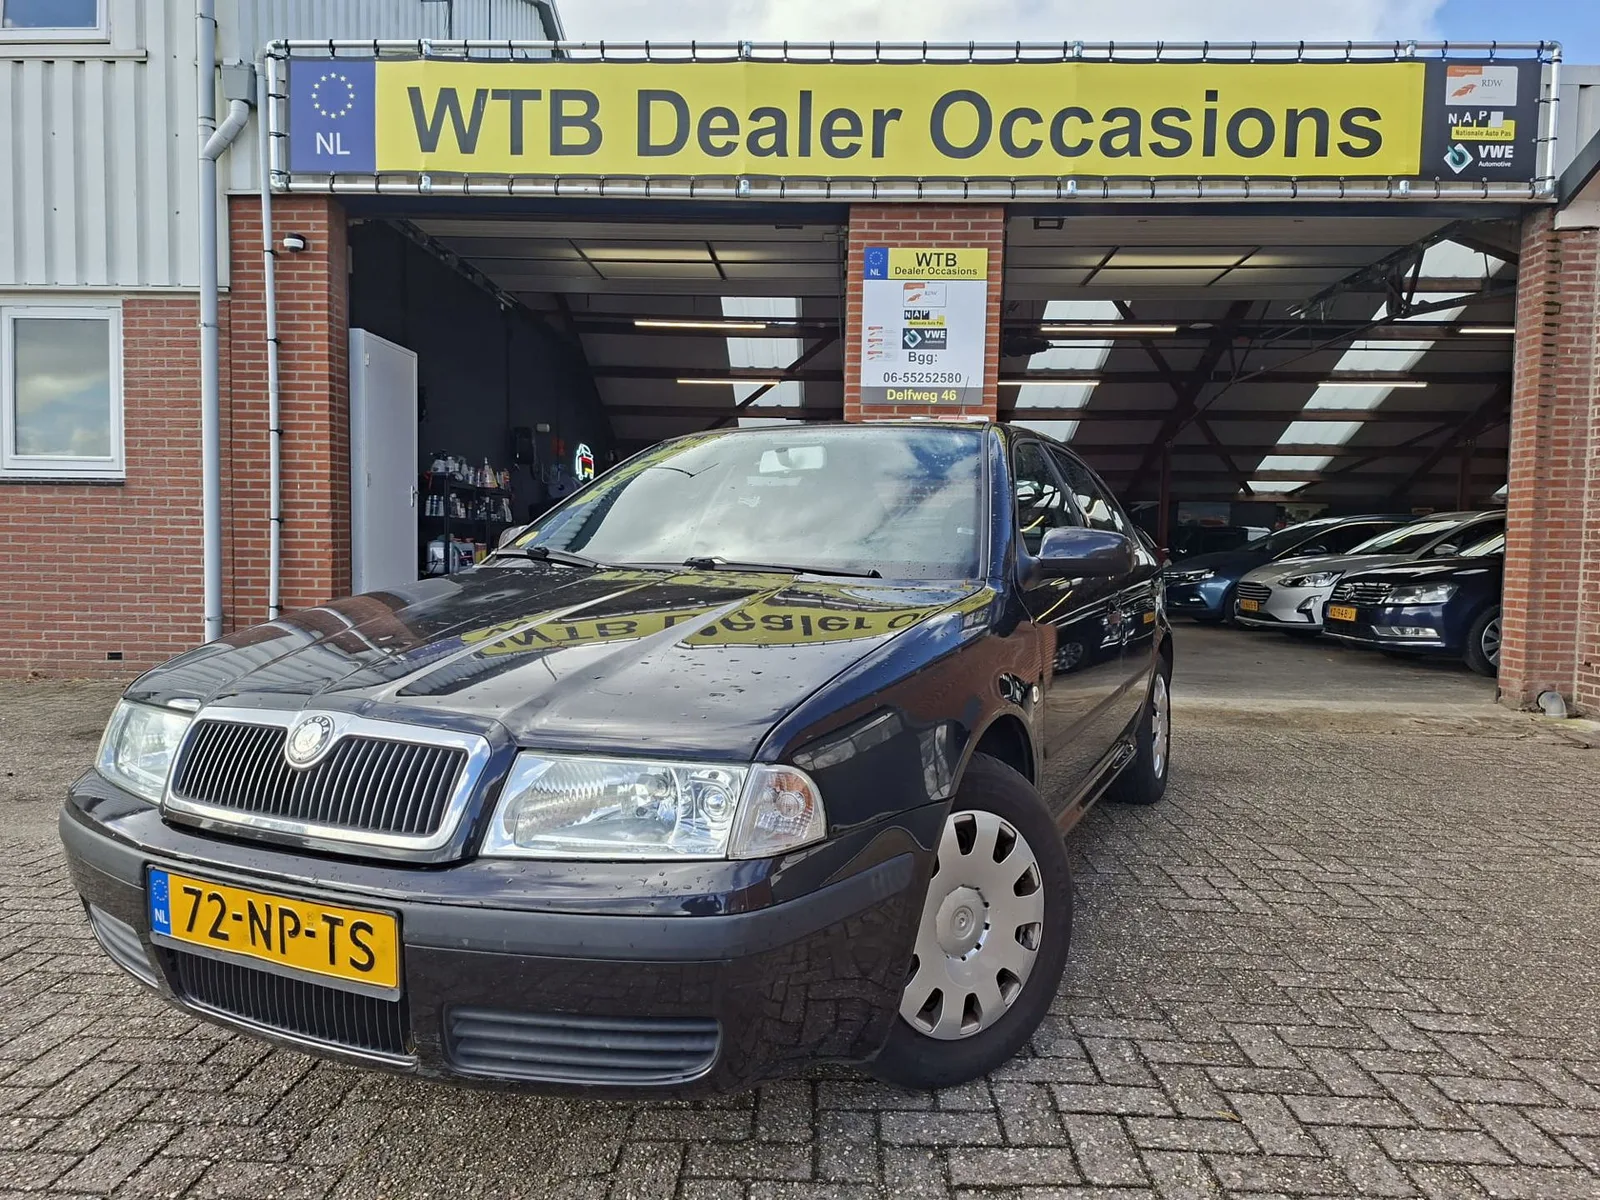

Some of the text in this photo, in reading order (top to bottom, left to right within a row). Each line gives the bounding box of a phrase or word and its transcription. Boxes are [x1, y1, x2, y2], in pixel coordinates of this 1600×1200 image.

[1481, 79, 1503, 88] RDW
[407, 86, 1383, 159] WTB Dealer Occasions
[1500, 129, 1512, 137] Pas
[315, 132, 351, 155] NL
[1478, 145, 1514, 159] VWE
[916, 252, 957, 267] WTB
[894, 266, 978, 276] Dealer Occasions
[924, 330, 946, 339] VWE
[908, 352, 938, 365] Bgg:
[883, 372, 962, 384] 06-55252580
[886, 389, 957, 403] Delfweg 46
[154, 907, 169, 925] NL
[182, 886, 375, 973] 72-NP-TS
